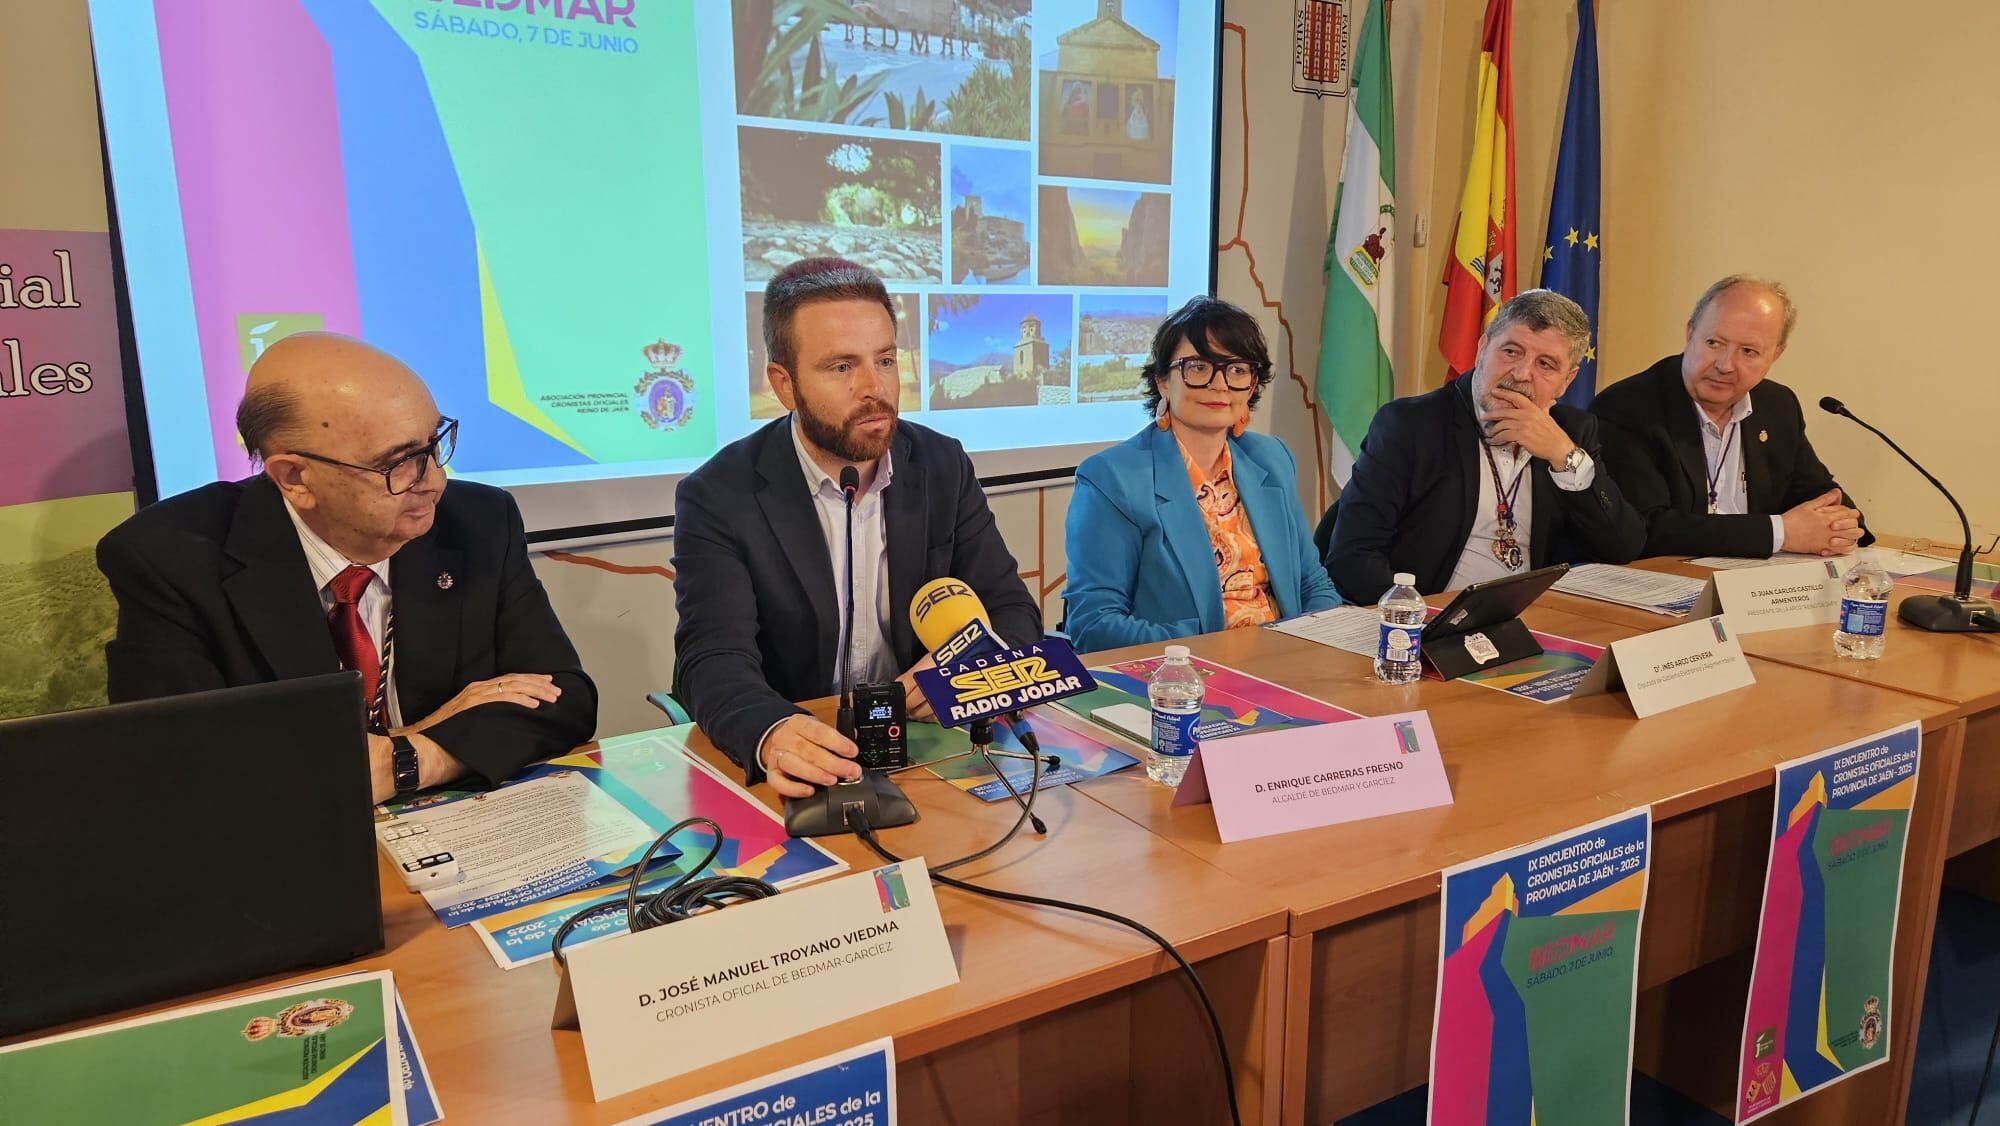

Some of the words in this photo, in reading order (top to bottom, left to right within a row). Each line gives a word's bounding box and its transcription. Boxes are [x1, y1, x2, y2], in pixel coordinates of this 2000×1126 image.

[414, 9, 523, 43] SÁBADO,
[527, 25, 539, 42] 7
[544, 28, 573, 47] DE
[578, 31, 638, 54] JUNIO
[844, 23, 972, 57] BEDMAR
[1296, 10, 1304, 65] POTIVS
[915, 584, 972, 624] SER
[1775, 586, 1797, 595] CARLOS
[936, 623, 983, 666] SER
[939, 645, 1043, 677] CADENA
[950, 656, 1061, 703] SER
[950, 693, 1013, 720] RADIO
[1018, 676, 1082, 702] JODAR
[1833, 763, 1869, 784] CRONISTAS
[1869, 753, 1901, 771] OFICIALES
[1834, 759, 1841, 770] IX
[1841, 747, 1880, 767] ENCUENTRO
[1880, 745, 1889, 754] de
[1255, 784, 1266, 793] D.
[1268, 776, 1312, 791] ENRIQUE
[1314, 768, 1364, 784] CARRERAS
[1366, 761, 1404, 775] FRESNO
[1832, 778, 1868, 799] PROVINCIA
[1868, 774, 1878, 783] DE
[1897, 763, 1913, 776] 2025
[1272, 789, 1308, 804] ALCALDE
[1309, 789, 1321, 797] DE
[1322, 782, 1355, 796] BEDMAR
[1356, 782, 1361, 790] Y
[1527, 861, 1579, 888] CRONISTAS
[1579, 846, 1624, 868] OFICIALES
[1624, 842, 1635, 855] de
[1635, 840, 1645, 851] la
[1528, 858, 1539, 873] IX
[1539, 840, 1593, 868] ENCUENTRO
[1594, 837, 1606, 849] de
[515, 882, 530, 890] DE
[520, 875, 585, 903] ENCUENTRO
[530, 862, 588, 887] PROVINCIA
[533, 867, 592, 892] CRONISTAS
[1526, 878, 1577, 905] PROVINCIA
[1578, 873, 1591, 887] DE
[1591, 865, 1614, 882] JAÉN
[1619, 856, 1640, 872] 2025
[478, 890, 532, 909] OFICIALES
[506, 920, 546, 936] 2025
[506, 938, 523, 946] la
[524, 931, 545, 940] de
[638, 993, 656, 1008] D.
[658, 977, 701, 1002] JOSÉ
[703, 959, 769, 988] MANUEL
[771, 937, 841, 968] TROYANO
[843, 920, 899, 945] VIEDMA
[1575, 956, 1587, 969] DE
[1587, 945, 1614, 964] JUNIO
[656, 994, 721, 1023] CRONISTA
[722, 979, 770, 1002] OFICIAL
[772, 972, 790, 986] DE
[792, 941, 894, 981] BEDMAR-GARCÍEZ
[772, 1095, 796, 1114] de
[840, 1097, 862, 1115] de
[865, 1090, 881, 1106] la
